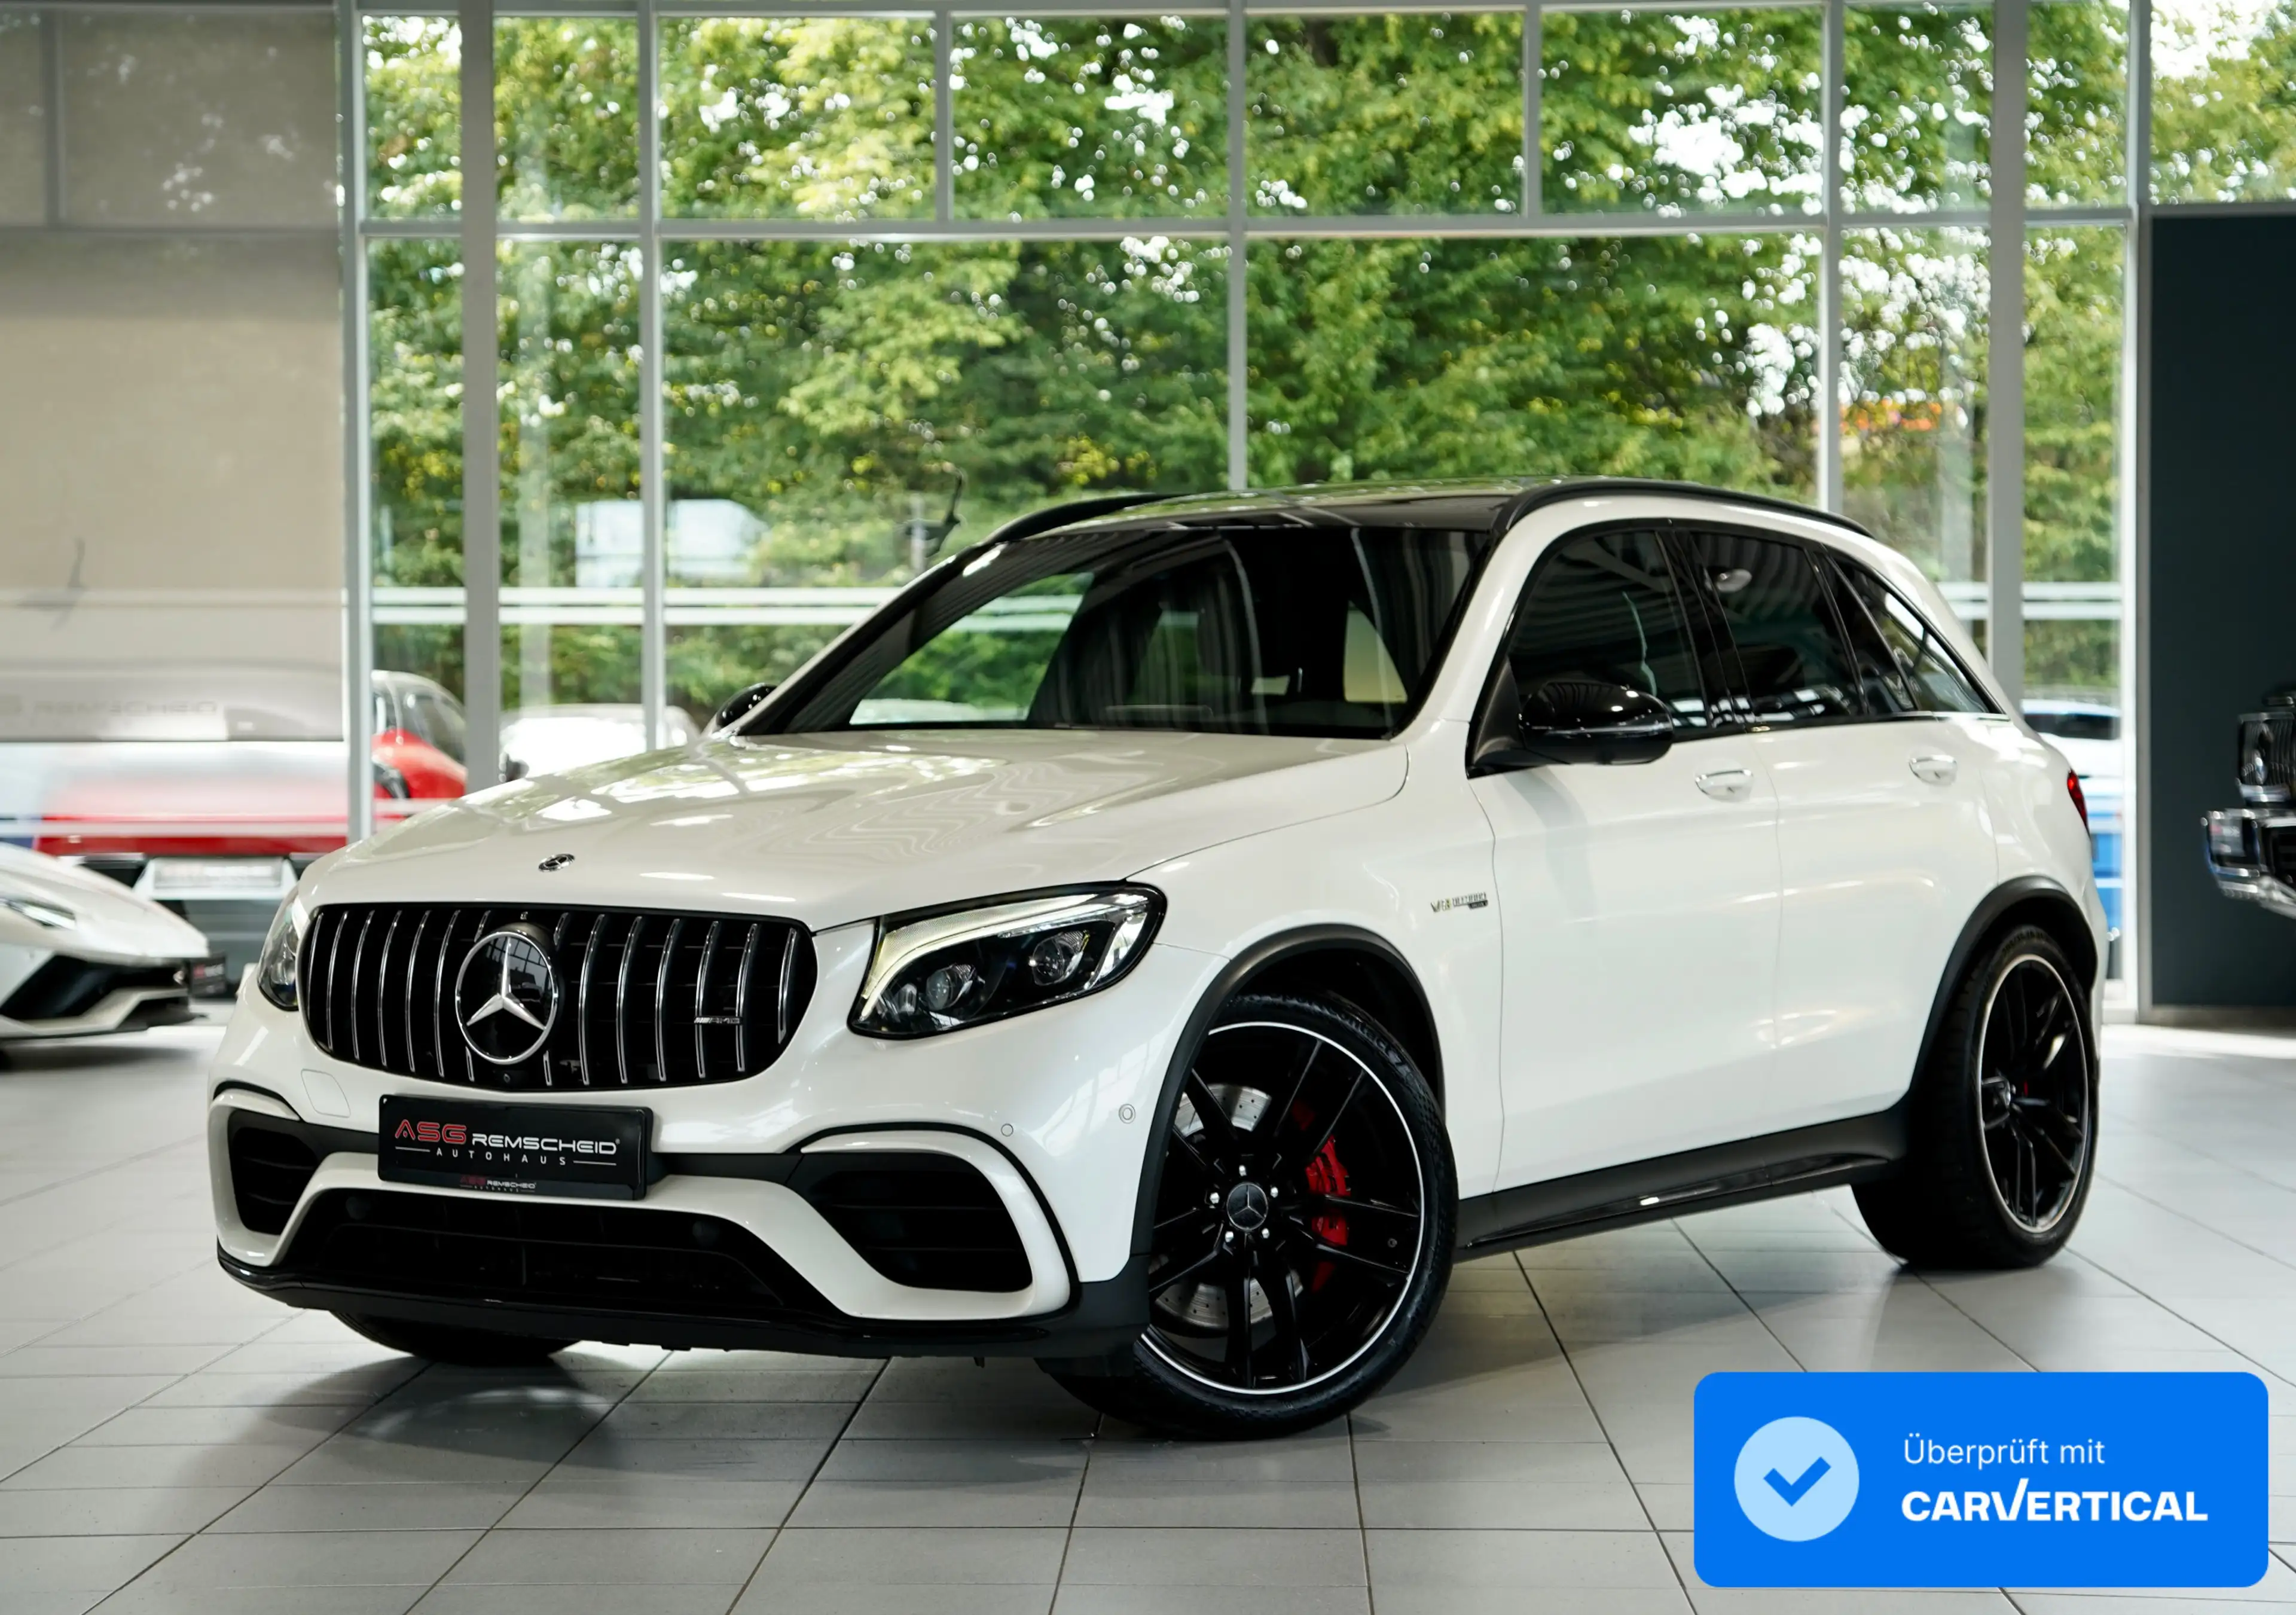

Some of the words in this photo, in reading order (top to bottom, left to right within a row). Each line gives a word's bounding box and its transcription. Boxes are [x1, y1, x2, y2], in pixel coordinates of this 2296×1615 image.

[395, 1119, 466, 1144] ASG
[472, 1133, 617, 1155] REMSCHEID
[436, 1147, 566, 1165] AUTOHAUS
